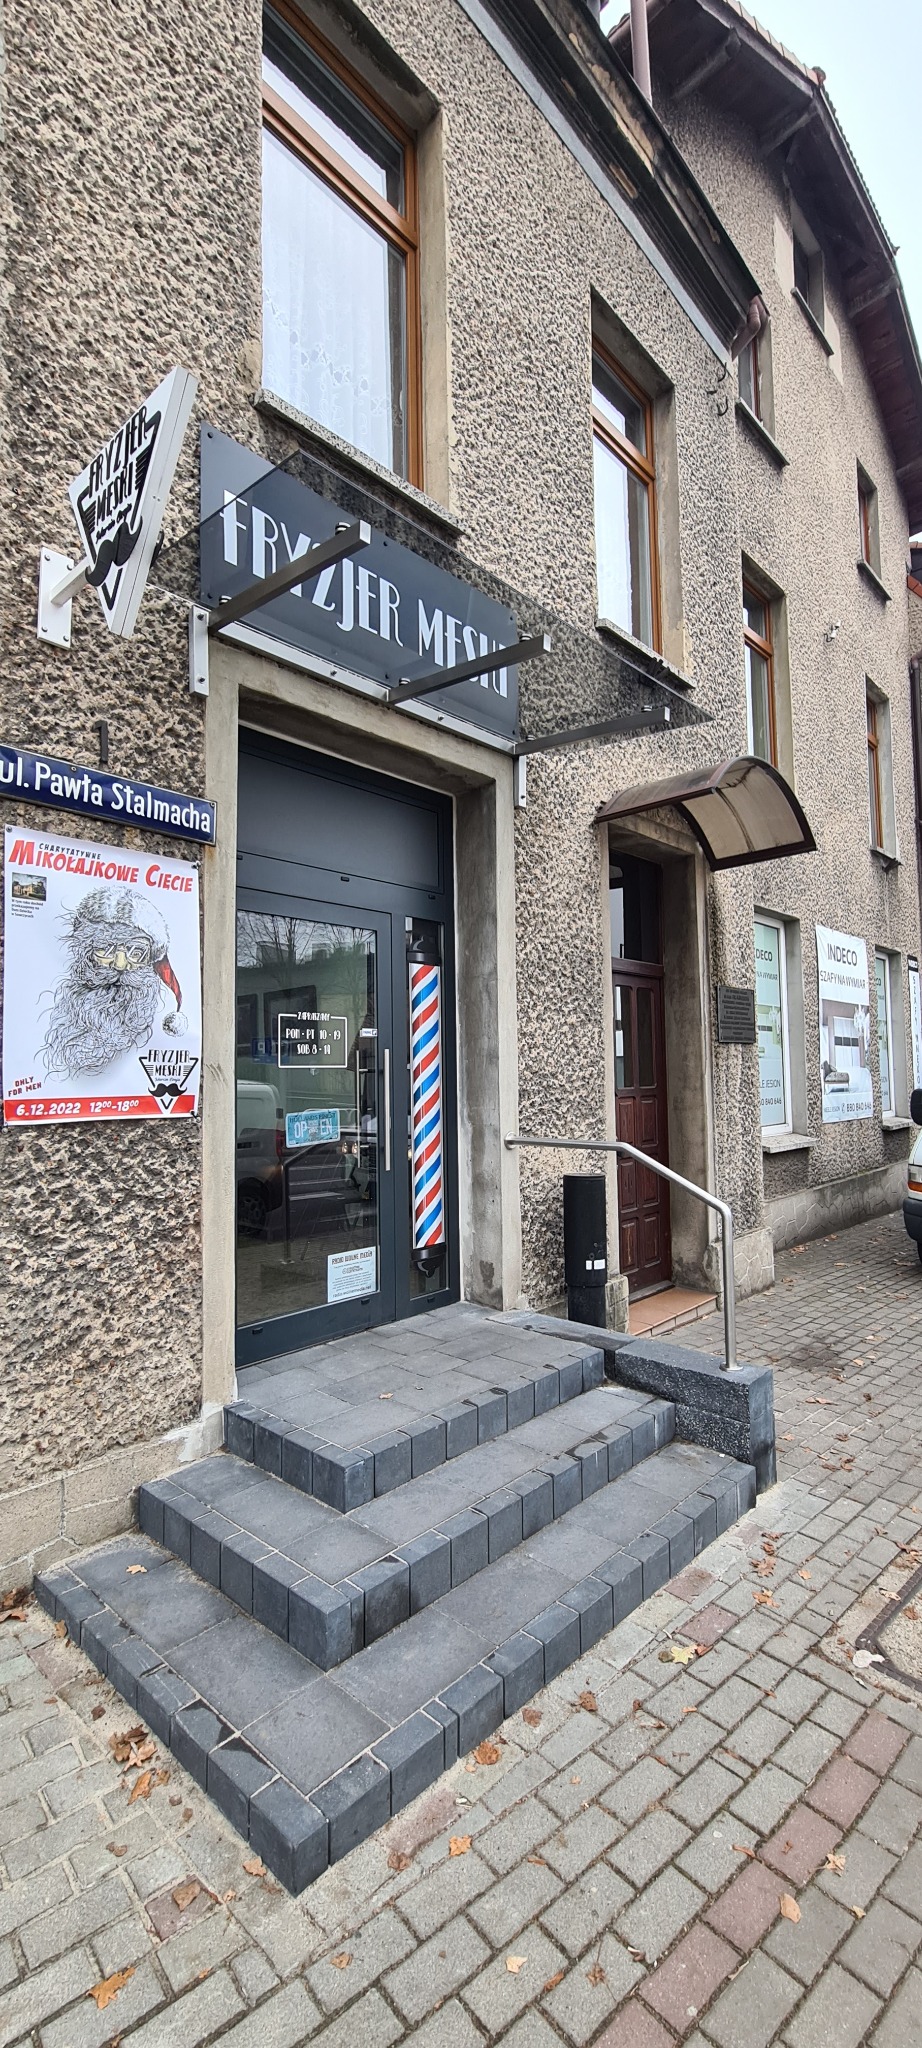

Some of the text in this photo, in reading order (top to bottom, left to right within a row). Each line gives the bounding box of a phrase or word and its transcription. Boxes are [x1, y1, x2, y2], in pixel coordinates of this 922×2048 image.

[88, 405, 148, 499] FRYZJER
[219, 488, 404, 647] FRYZJER
[92, 720, 109, 764] 1
[0, 756, 211, 834] ul. Pawła Stalmacha
[38, 842, 102, 860] CHARYTATYWNE
[8, 839, 194, 893] MIKOŁAJKOWE CIĘCIE
[755, 948, 773, 962] DECO
[827, 943, 858, 967] INDECO
[285, 1028, 301, 1039] PON
[306, 1028, 315, 1040] PT
[319, 1029, 328, 1040] 10
[333, 1030, 341, 1040] 19
[147, 1049, 190, 1066] FRYZJER
[296, 1044, 310, 1055] SOB
[311, 1044, 318, 1055] 8
[155, 1064, 182, 1077] MĘSKI
[8, 1081, 42, 1098] FOR MEN
[14, 1076, 34, 1088] ONLY
[15, 1102, 82, 1117] 6.12.2022
